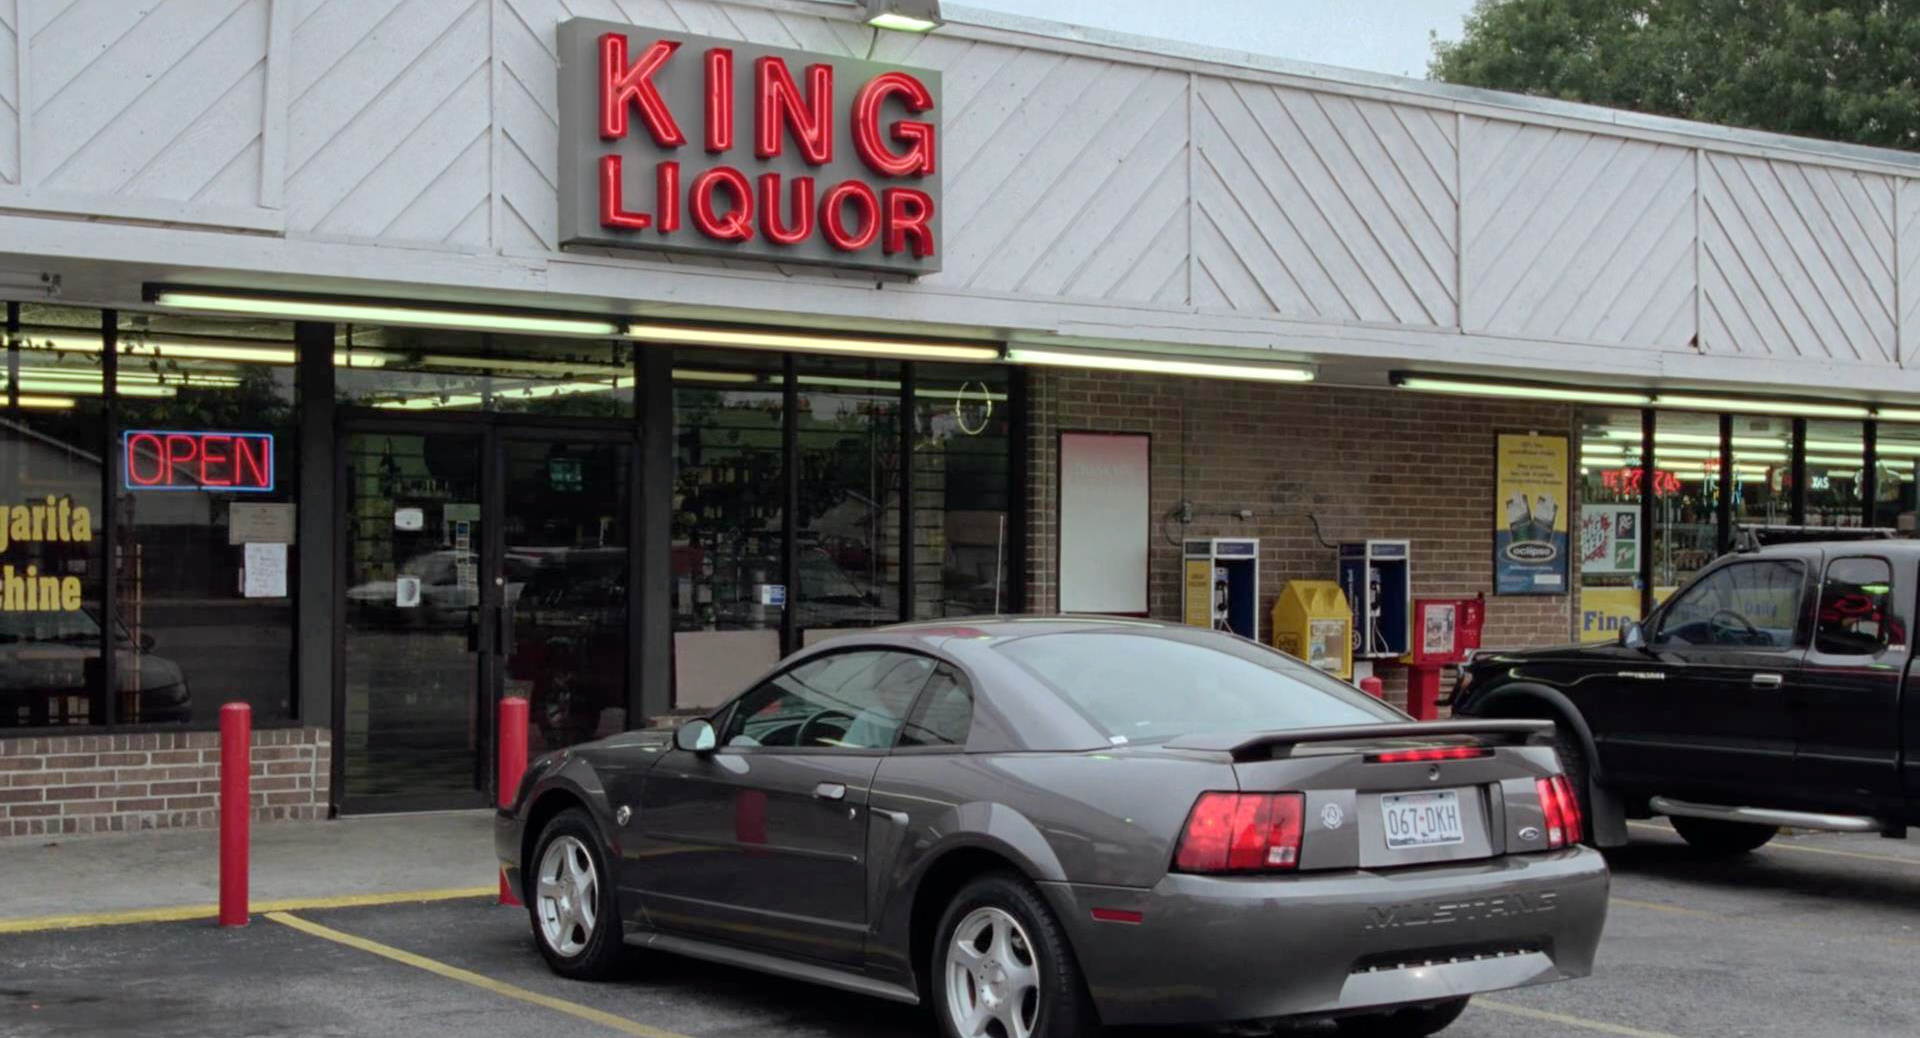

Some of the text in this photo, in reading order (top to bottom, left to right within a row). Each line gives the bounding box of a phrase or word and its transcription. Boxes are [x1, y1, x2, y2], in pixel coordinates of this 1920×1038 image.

[599, 32, 935, 176] KING
[600, 154, 934, 258] LIQUOR
[128, 433, 269, 488] OPEN
[0, 565, 81, 611] hine
